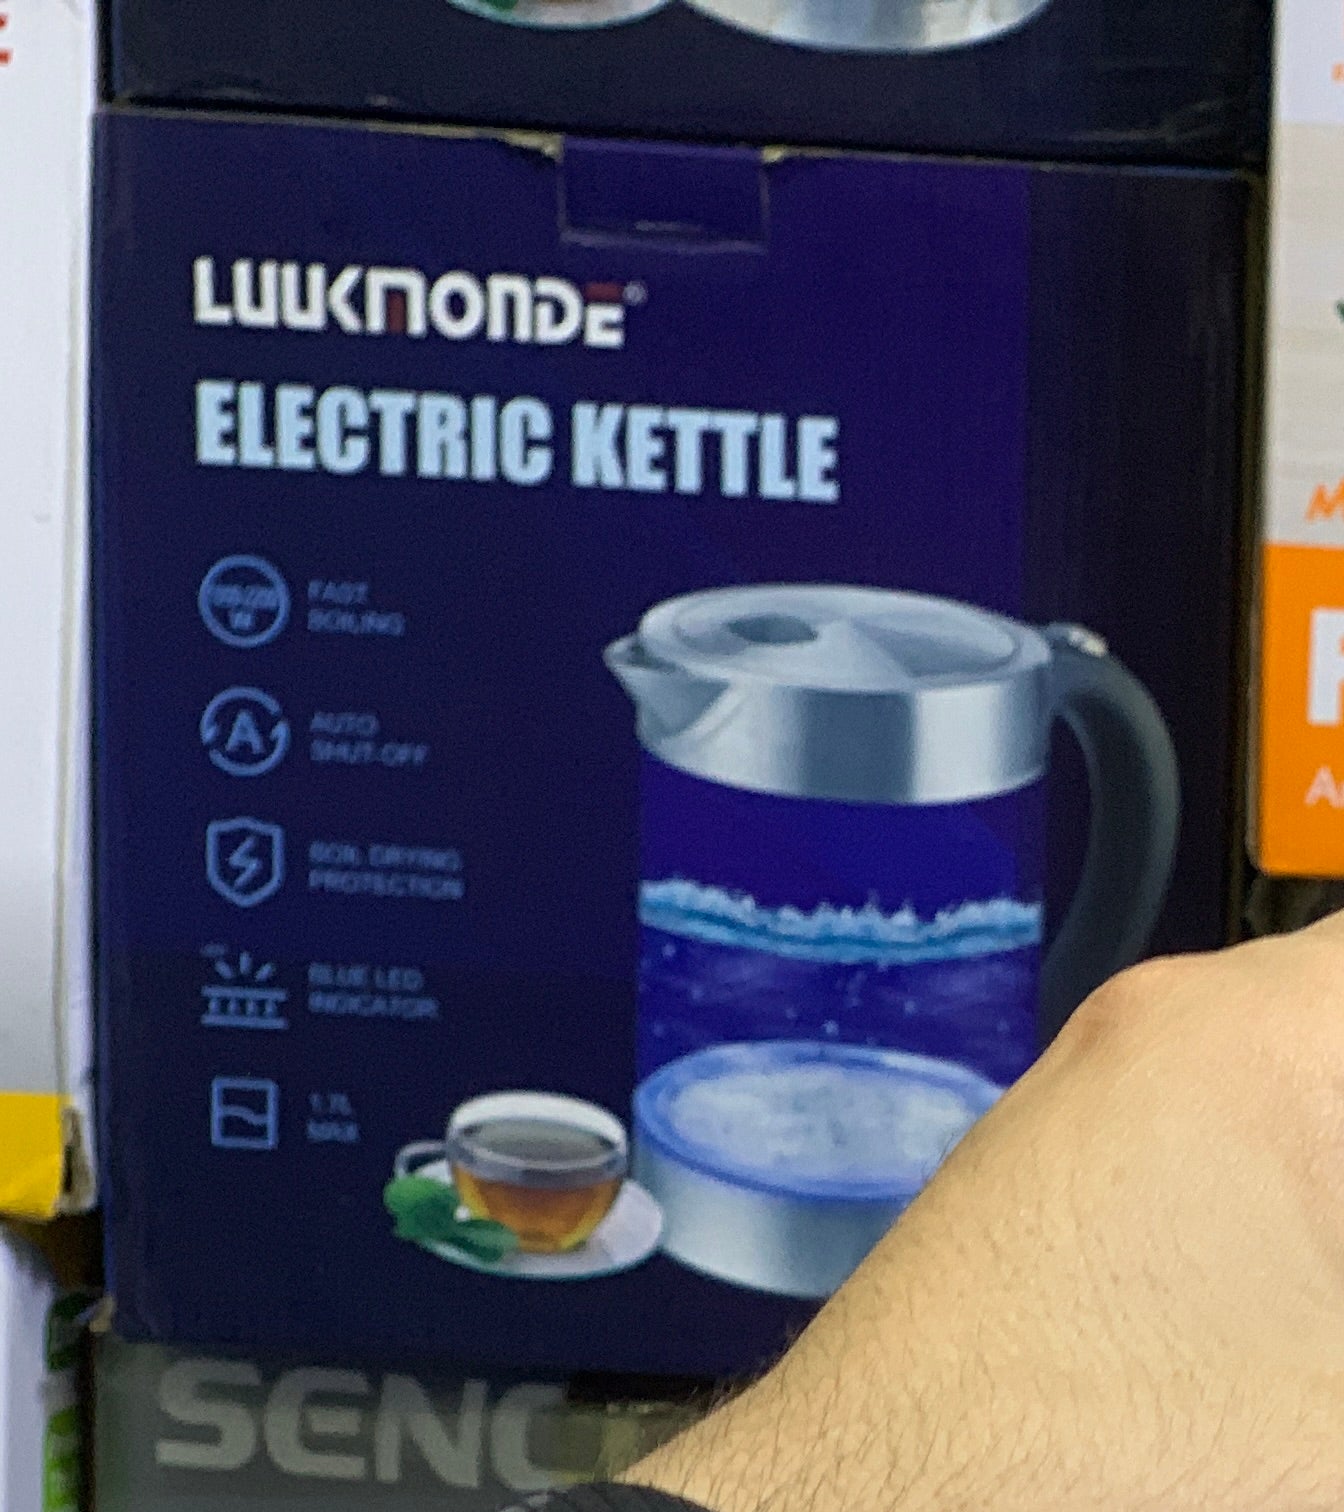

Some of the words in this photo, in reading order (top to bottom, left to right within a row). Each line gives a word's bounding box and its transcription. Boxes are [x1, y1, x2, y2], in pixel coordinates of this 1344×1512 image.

[196, 380, 554, 486] ELECTRIC
[571, 400, 840, 502] KETTLE
[155, 1357, 570, 1492] SENC
